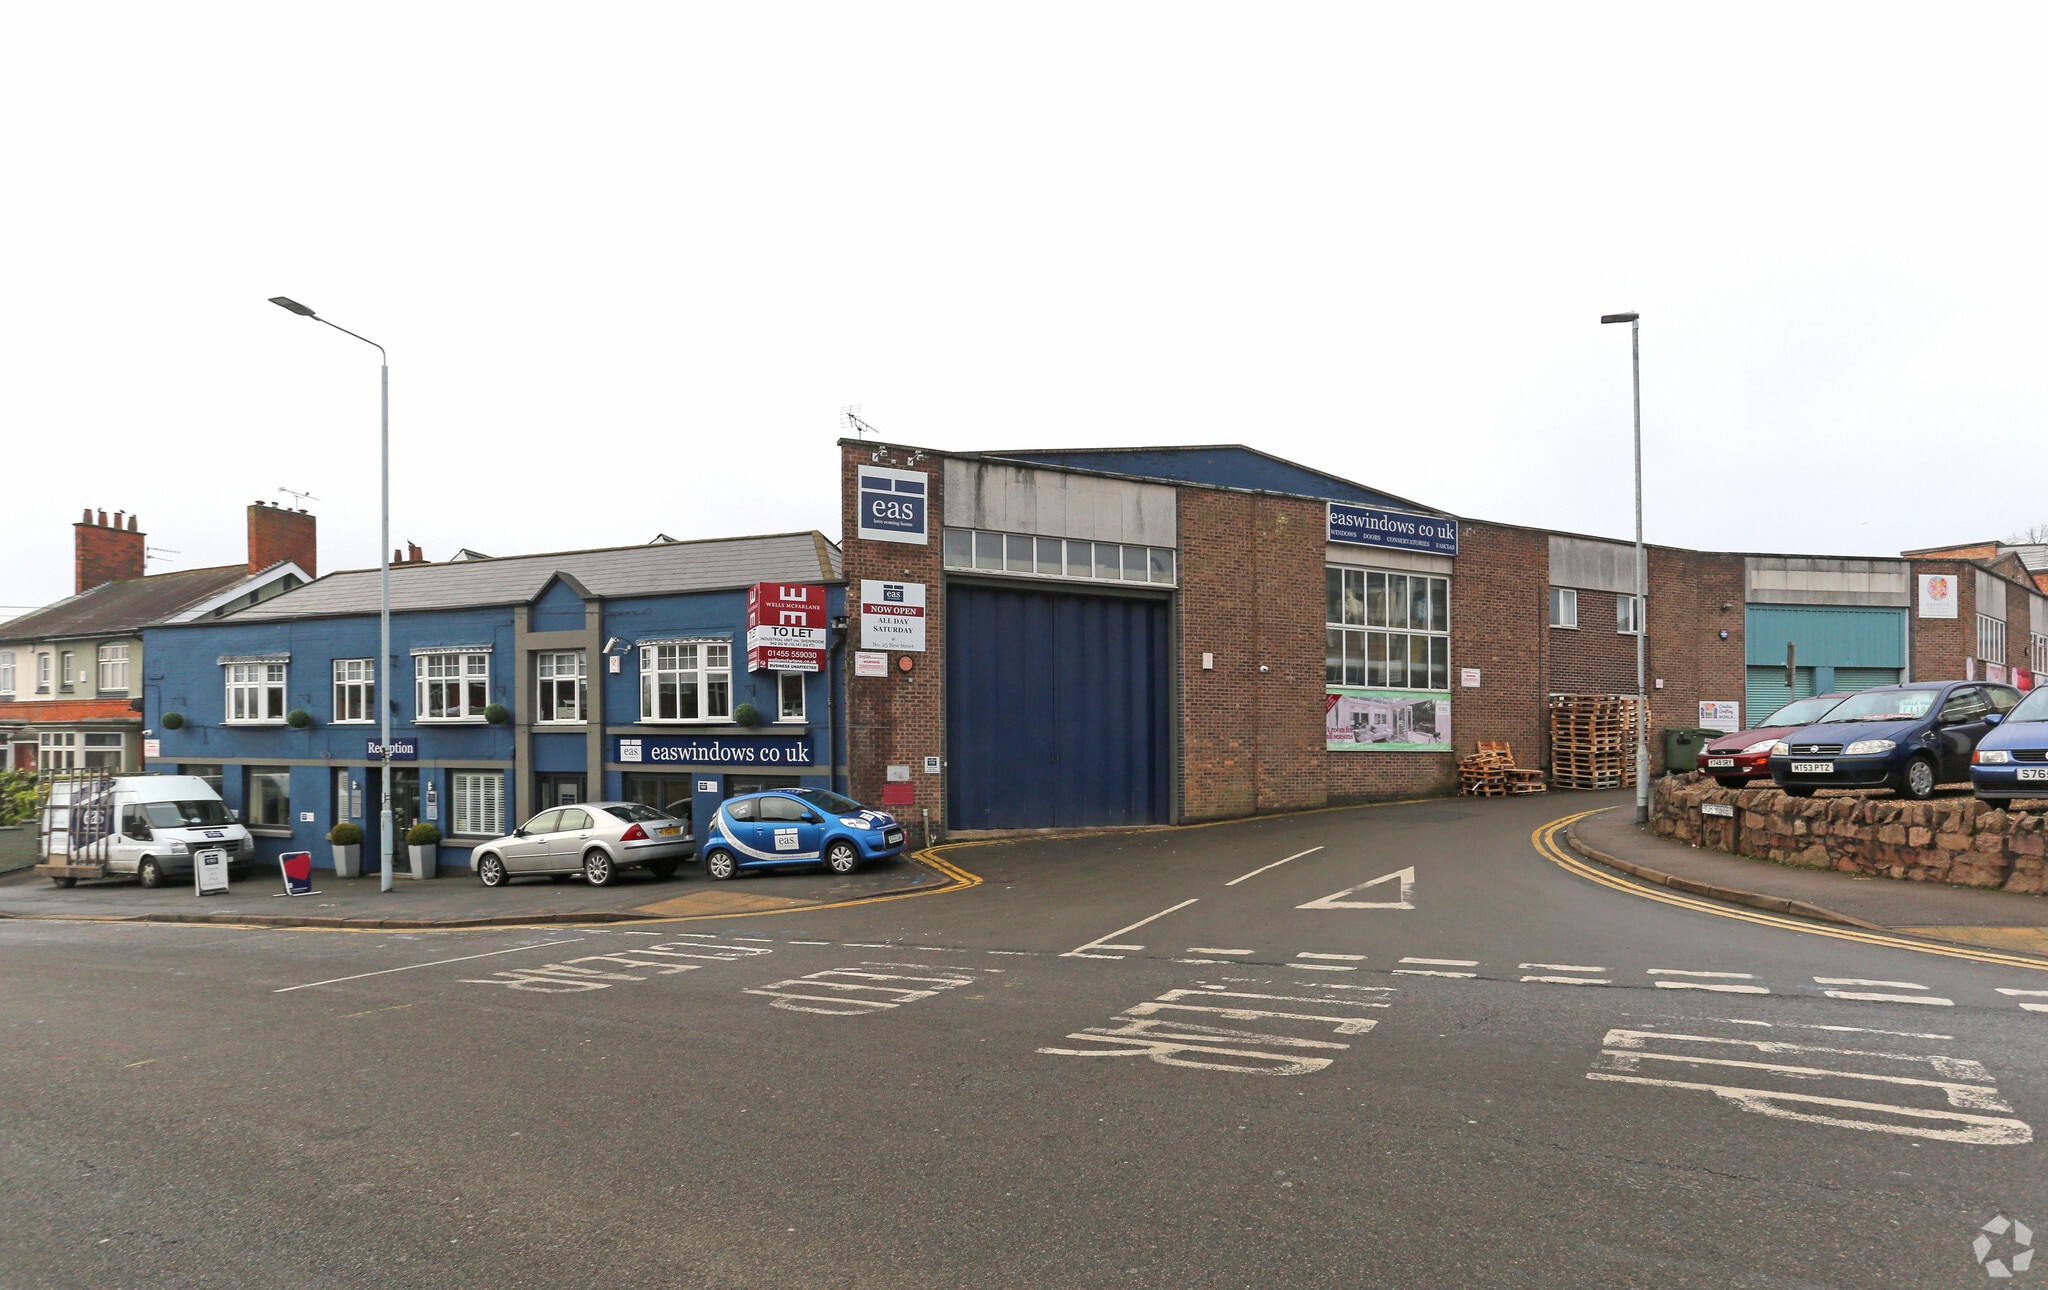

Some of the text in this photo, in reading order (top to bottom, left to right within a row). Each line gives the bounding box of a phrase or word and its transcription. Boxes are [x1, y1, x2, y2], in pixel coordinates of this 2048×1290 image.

[1330, 528, 1455, 550] WINDOWS DOORS CONSERVATORIES FASCIAS
[870, 605, 916, 615] NOW OPEN
[772, 626, 814, 638] TO LET
[873, 626, 914, 634] SATURDAY
[790, 650, 817, 658] 559030
[368, 742, 414, 756] Recption
[1814, 764, 1830, 772] PTZ
[2022, 769, 2048, 779] S76
[456, 942, 774, 994] CLEAR
